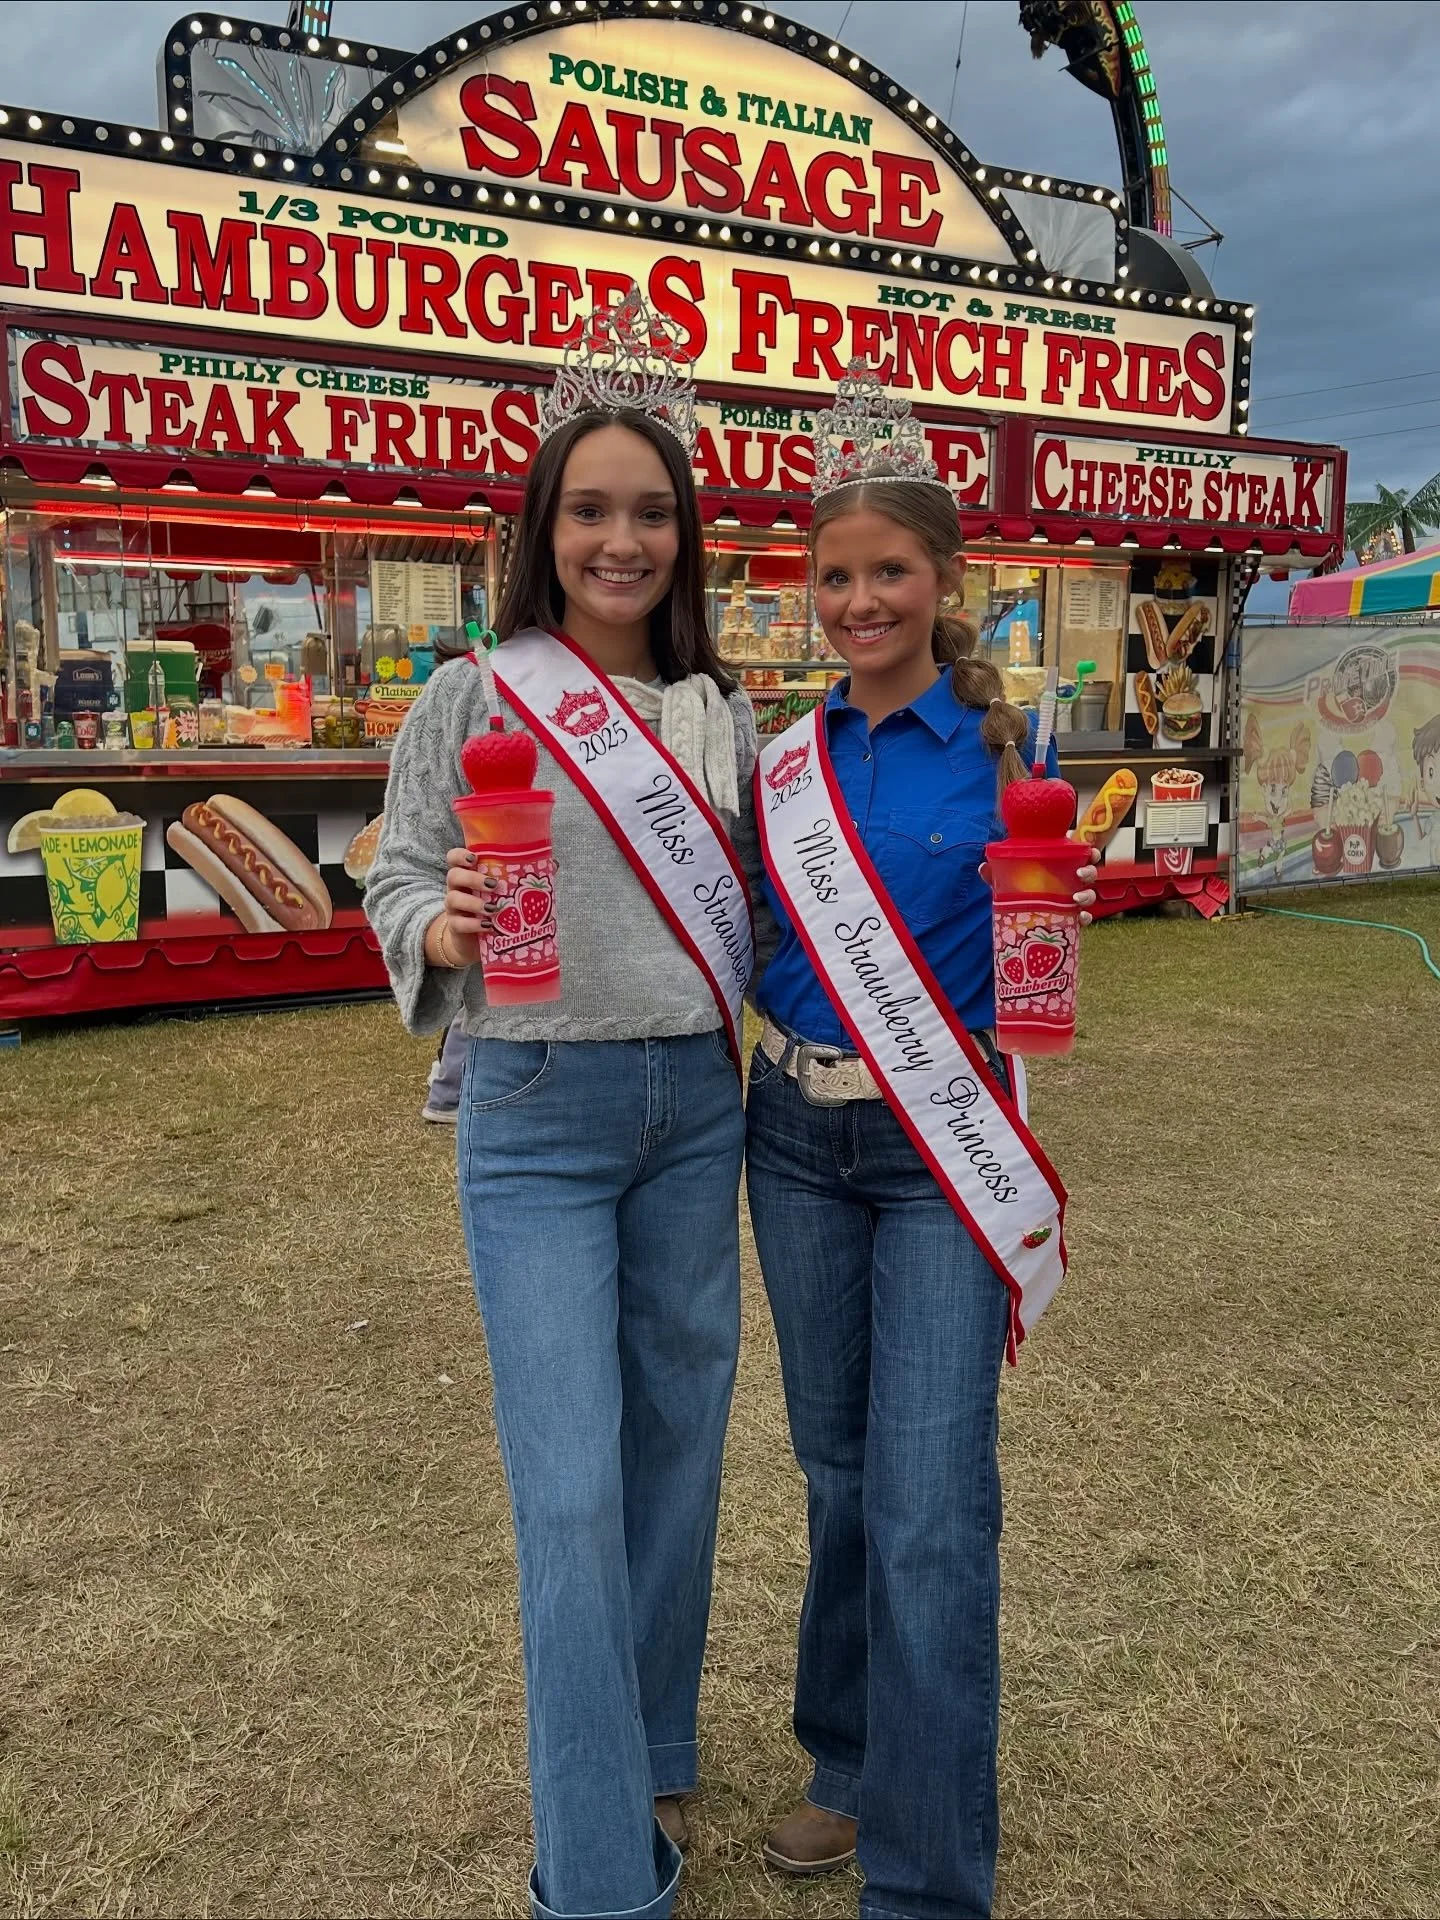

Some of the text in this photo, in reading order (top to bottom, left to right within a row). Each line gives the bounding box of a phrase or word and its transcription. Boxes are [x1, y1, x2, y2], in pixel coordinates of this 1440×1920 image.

[548, 52, 873, 145] POLISH & ITALIAN
[459, 73, 944, 247] SAUSAGE
[239, 190, 509, 248] 1/3 POUND
[0, 158, 708, 364] HAMBURGERS
[877, 284, 1116, 334] HOT & FRESH
[731, 268, 1226, 421] FRENCH FRIES
[158, 352, 431, 399] PHILLY CHEESE
[21, 340, 542, 477] STEAK FRIES
[719, 406, 792, 432] POLISH
[798, 413, 814, 433] &
[688, 426, 989, 506] AUSE
[1034, 438, 1324, 527] CHEESE STEAK
[1135, 447, 1237, 470] PHILLY
[375, 686, 423, 697] Nathan'
[366, 723, 395, 737] HOT
[579, 720, 628, 764] 2025
[770, 768, 812, 813] 2025
[71, 833, 138, 853] LEMONADE
[1347, 849, 1364, 857] CORN
[636, 774, 750, 993] Miss Strawber
[794, 818, 1019, 1203] Miss Strawberry Princess
[1000, 975, 1066, 997] Strawberry
